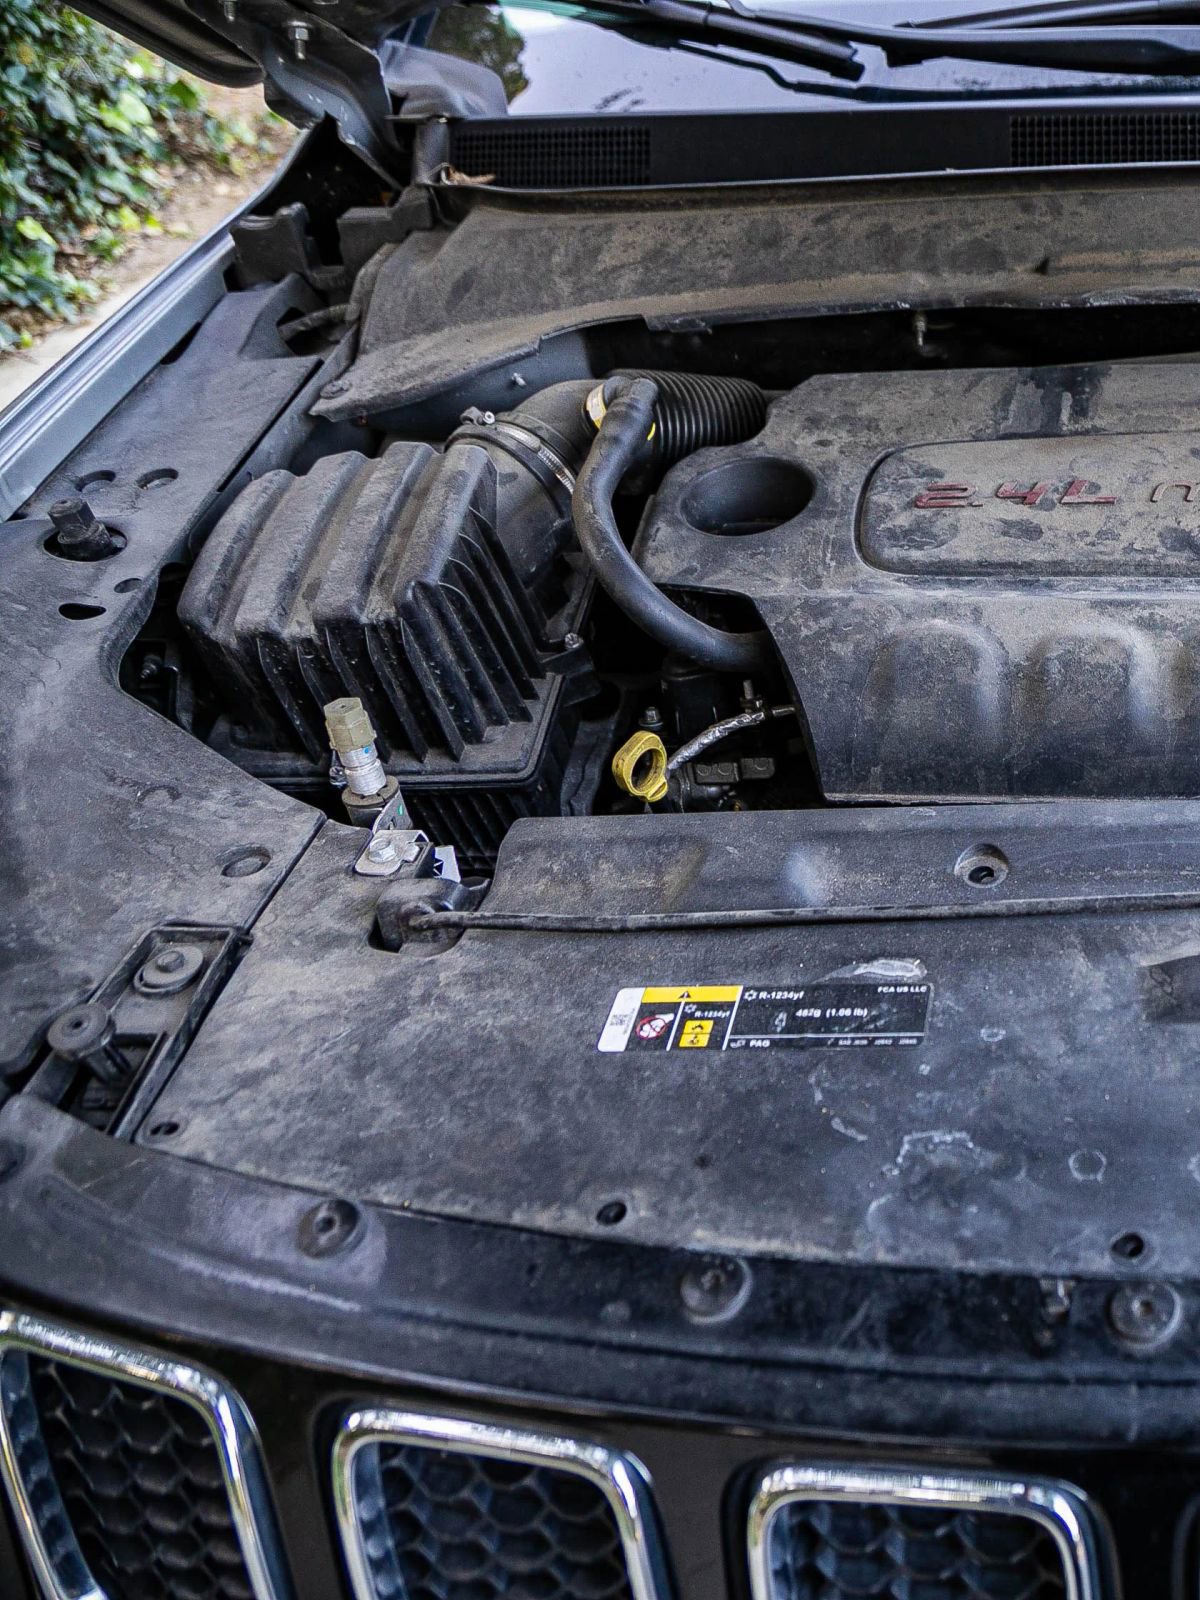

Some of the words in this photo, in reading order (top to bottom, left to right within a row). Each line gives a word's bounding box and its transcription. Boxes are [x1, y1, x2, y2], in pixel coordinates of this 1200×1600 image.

[913, 478, 1117, 509] 2.4L
[877, 985, 895, 993] FCA
[896, 985, 909, 993] US
[910, 985, 928, 993] LLC
[758, 990, 805, 1001] R-1234yf
[694, 1010, 731, 1019] R-1234yf
[853, 1007, 868, 1018] lb)
